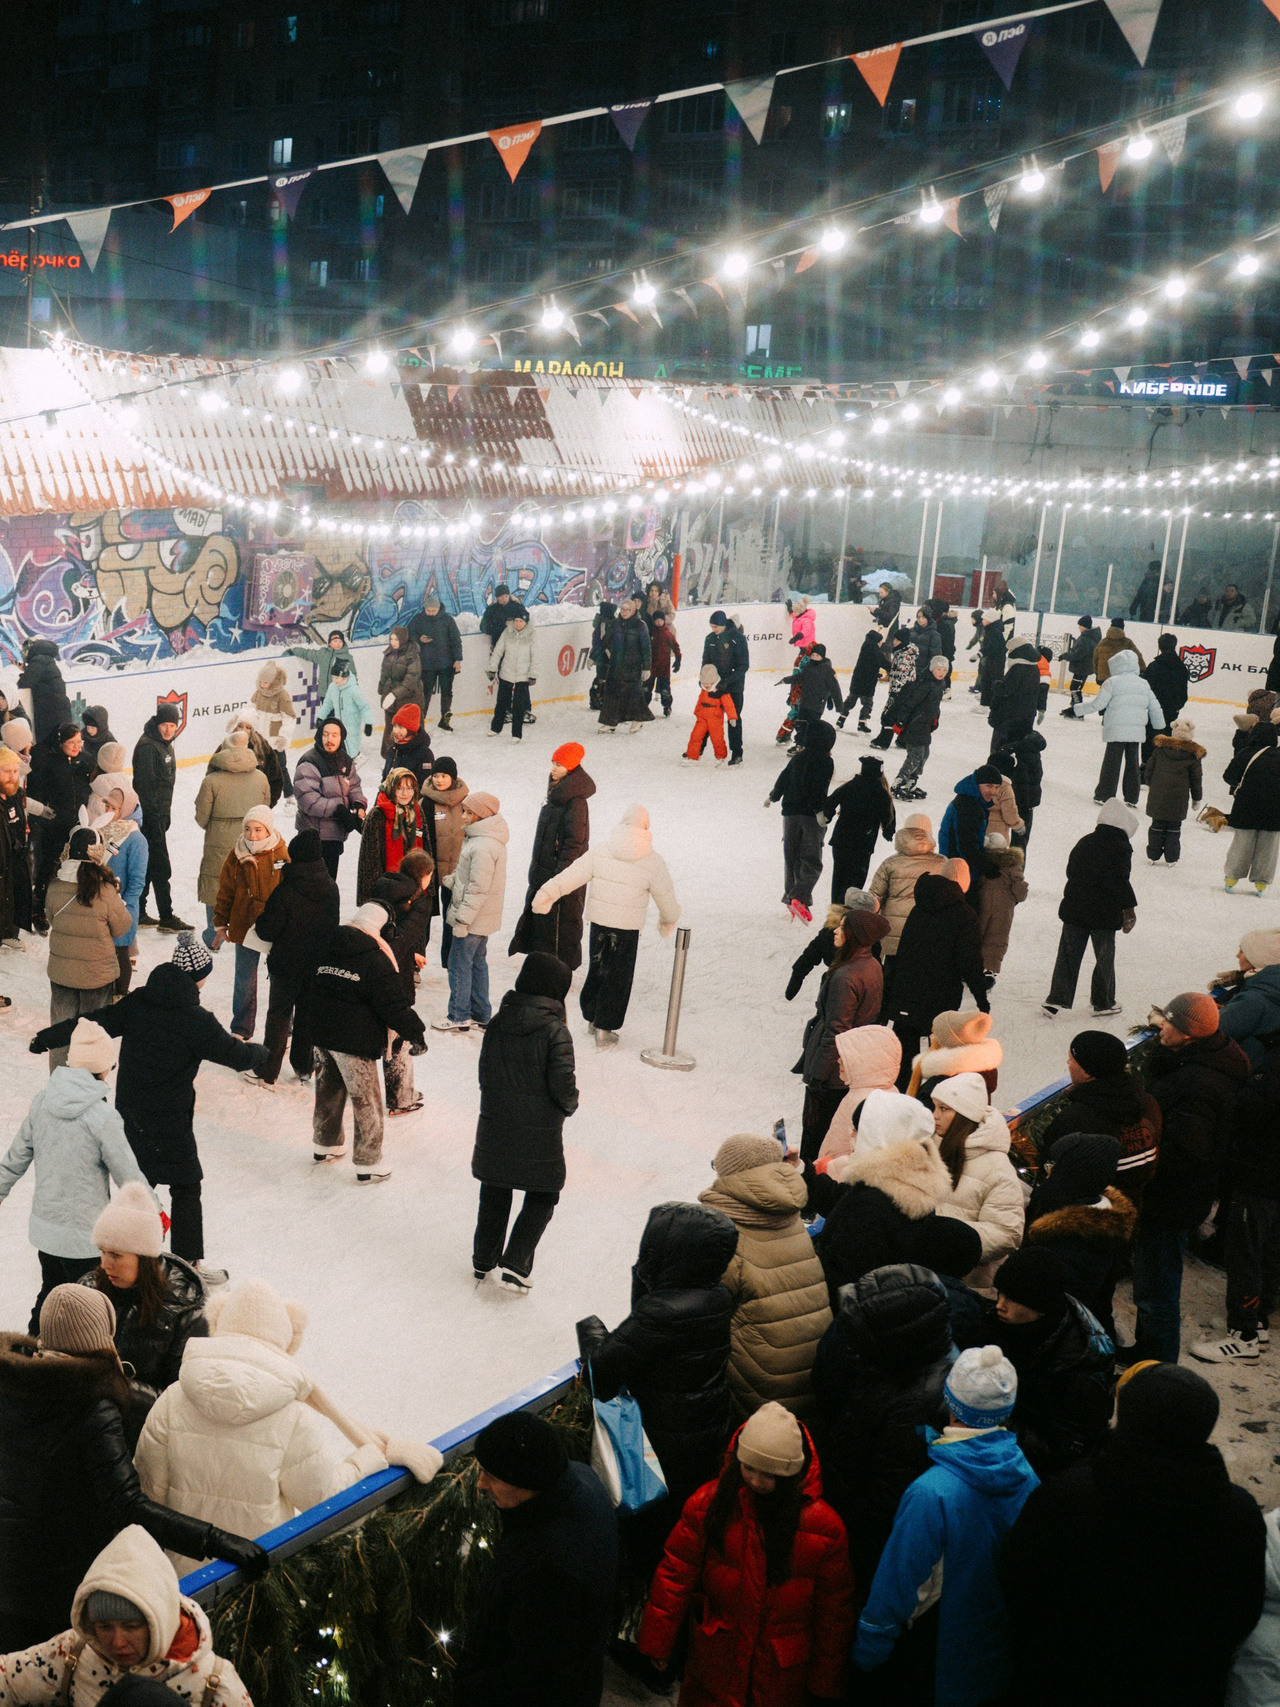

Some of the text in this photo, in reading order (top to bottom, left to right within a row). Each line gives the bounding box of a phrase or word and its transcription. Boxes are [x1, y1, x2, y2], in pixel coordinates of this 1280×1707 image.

[179, 509, 205, 528] MAD
[753, 633, 783, 641] БАРС
[1220, 662, 1270, 675] АК БА
[192, 707, 210, 718] АК
